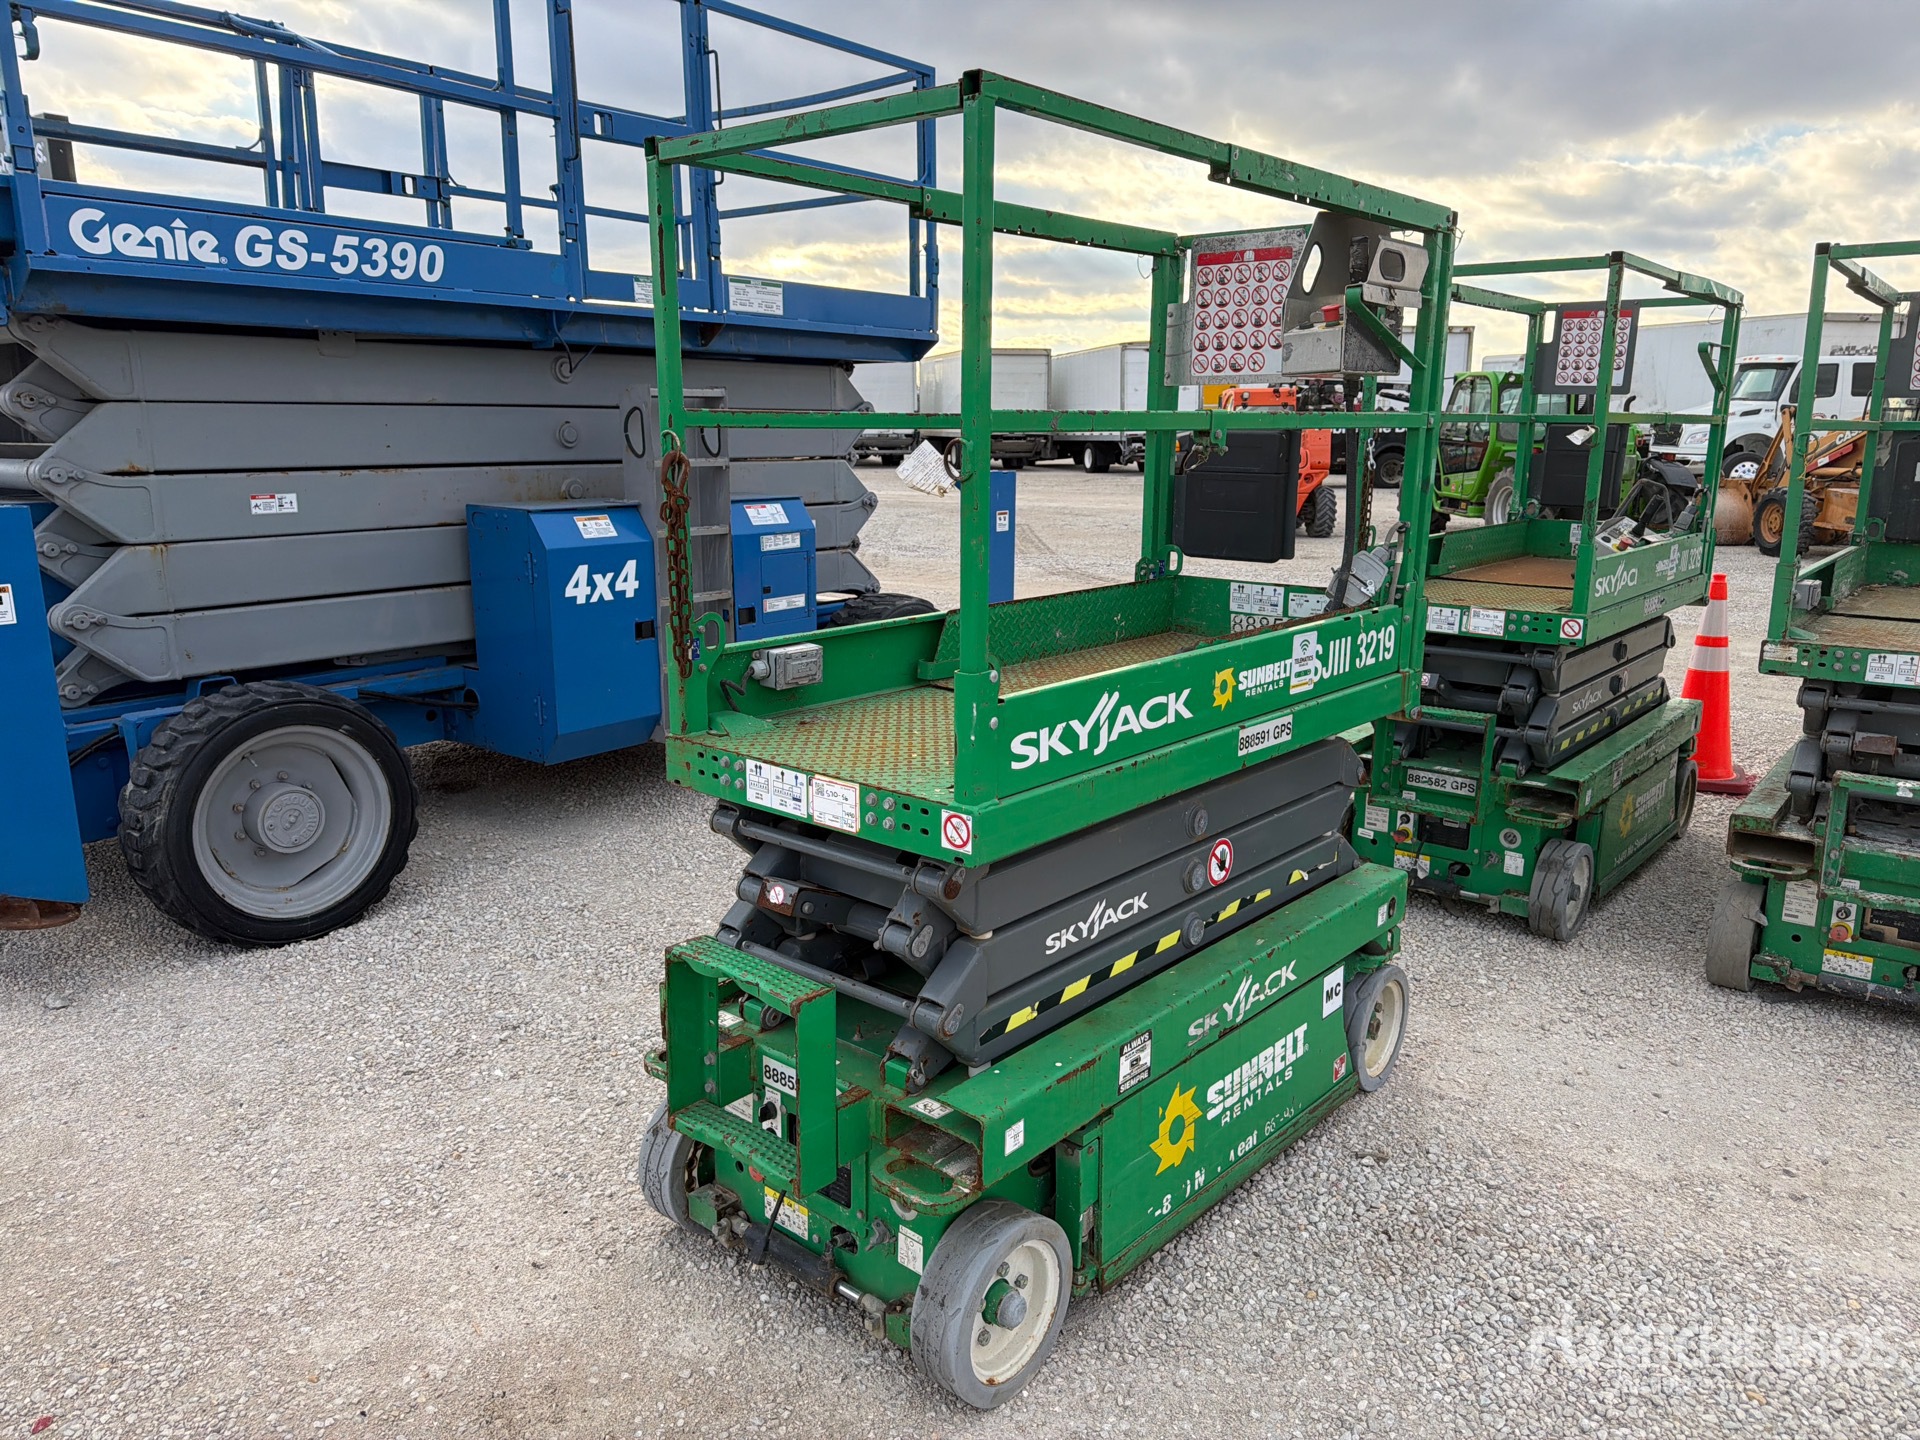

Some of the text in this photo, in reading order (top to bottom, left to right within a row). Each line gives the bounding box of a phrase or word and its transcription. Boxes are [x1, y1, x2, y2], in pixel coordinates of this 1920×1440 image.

[69, 208, 445, 283] Genie GS-5390
[1836, 430, 1862, 445] CA
[565, 559, 640, 605] 4x4
[1355, 624, 1396, 669] 3219
[1238, 659, 1293, 691] SUNBELT
[1245, 680, 1284, 698] RENTALS
[1010, 688, 1194, 770] SKYJACK
[1239, 721, 1292, 752] 888591 GPS
[1450, 780, 1476, 794] GPS
[1045, 891, 1150, 955] SKYJACK
[1325, 982, 1341, 1004] MC
[1123, 1032, 1150, 1055] ALWAYS
[764, 1063, 797, 1091] 8885
[1119, 1069, 1150, 1094] SIEMPRE
[1206, 1022, 1308, 1121] SUNBELT
